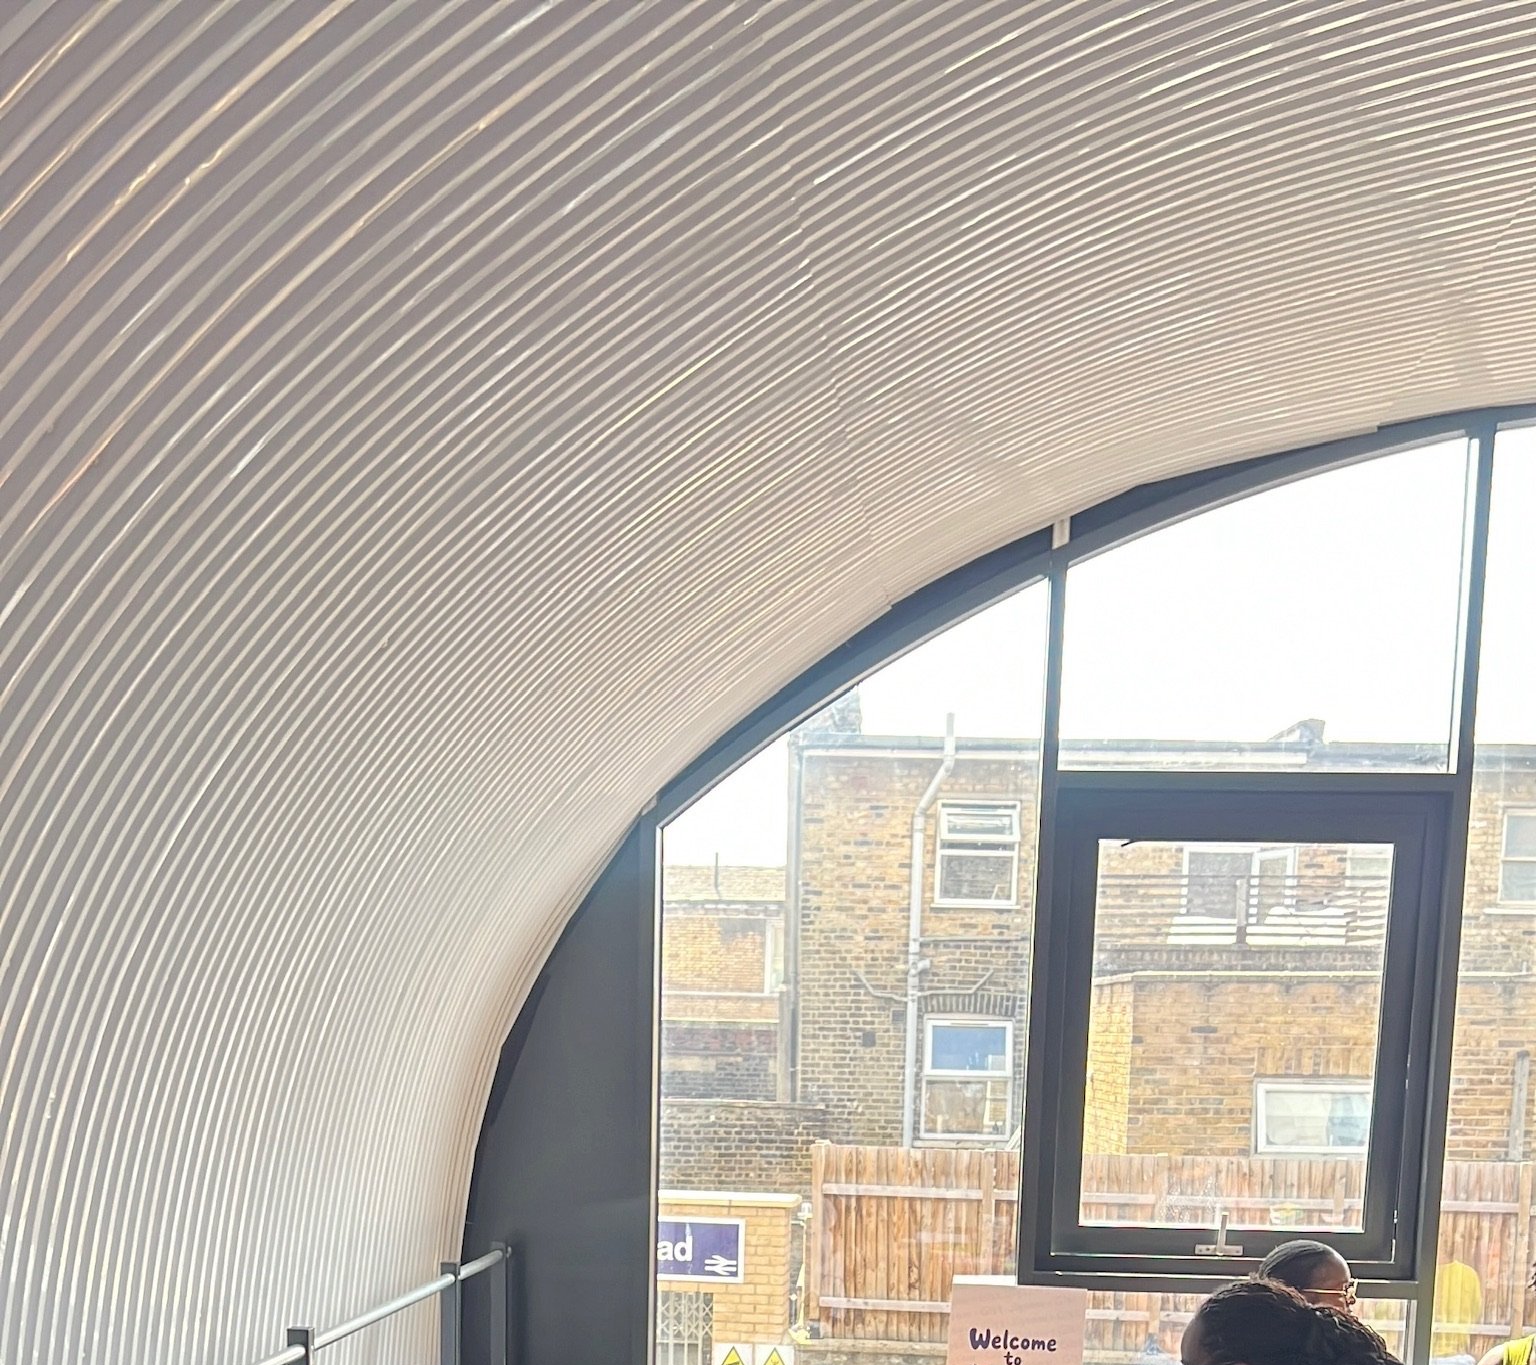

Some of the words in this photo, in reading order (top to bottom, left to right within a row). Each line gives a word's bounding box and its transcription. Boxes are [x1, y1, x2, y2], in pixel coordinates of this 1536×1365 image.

[658, 1235, 693, 1261] ad
[969, 1328, 1057, 1352] Welcome
[1004, 1351, 1022, 1365] to
